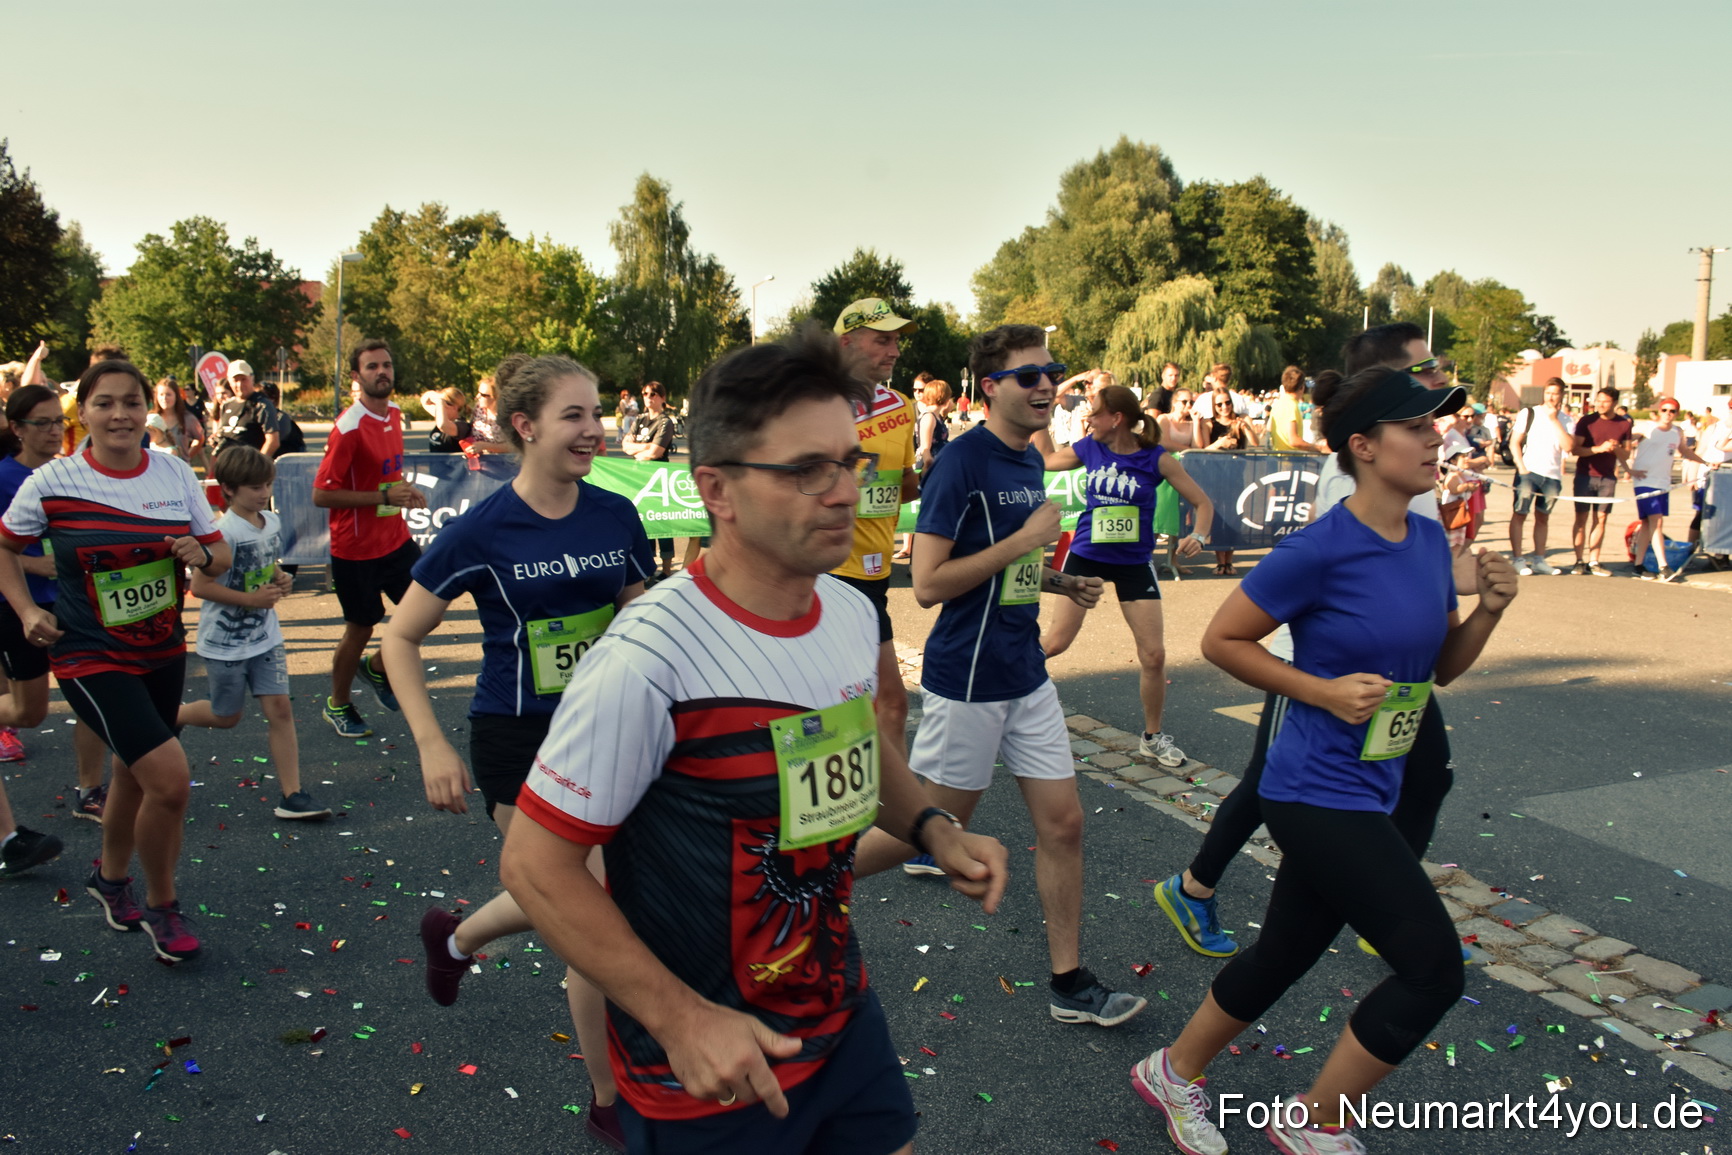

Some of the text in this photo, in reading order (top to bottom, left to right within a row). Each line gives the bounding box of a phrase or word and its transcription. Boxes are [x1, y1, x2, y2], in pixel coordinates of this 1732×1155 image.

[857, 412, 911, 441] AX BÖGL
[142, 500, 184, 510] NEUMARKT
[866, 486, 899, 504] 1329
[998, 491, 1027, 505] EURO
[1098, 518, 1133, 532] 1350
[513, 549, 626, 580] EURO POLES
[1015, 563, 1039, 587] 490
[109, 579, 167, 610] 1908
[556, 636, 602, 671] 50
[801, 740, 873, 806] 1887
